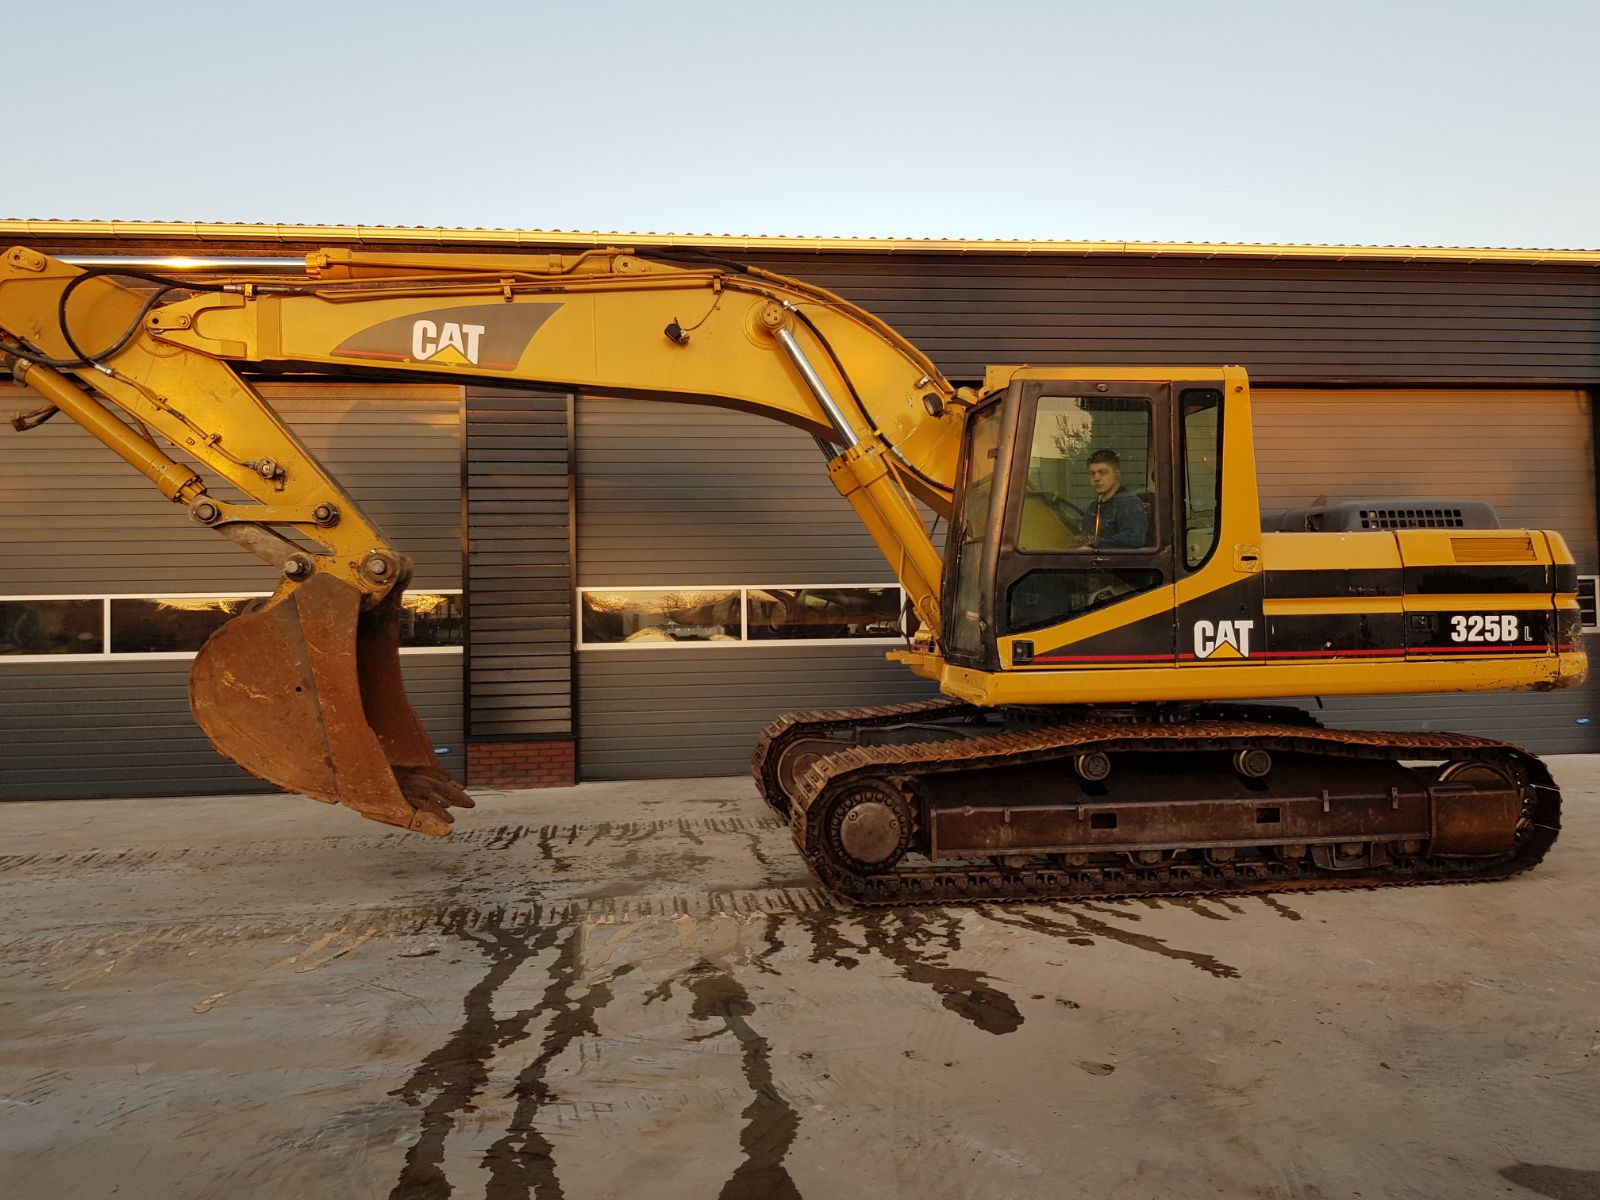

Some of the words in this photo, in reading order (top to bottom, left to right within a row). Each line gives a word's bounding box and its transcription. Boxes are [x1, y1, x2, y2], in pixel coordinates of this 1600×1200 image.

[412, 319, 485, 365] CAT
[1193, 620, 1254, 659] CAT
[1450, 615, 1518, 642] 325B
[1524, 625, 1533, 641] L
